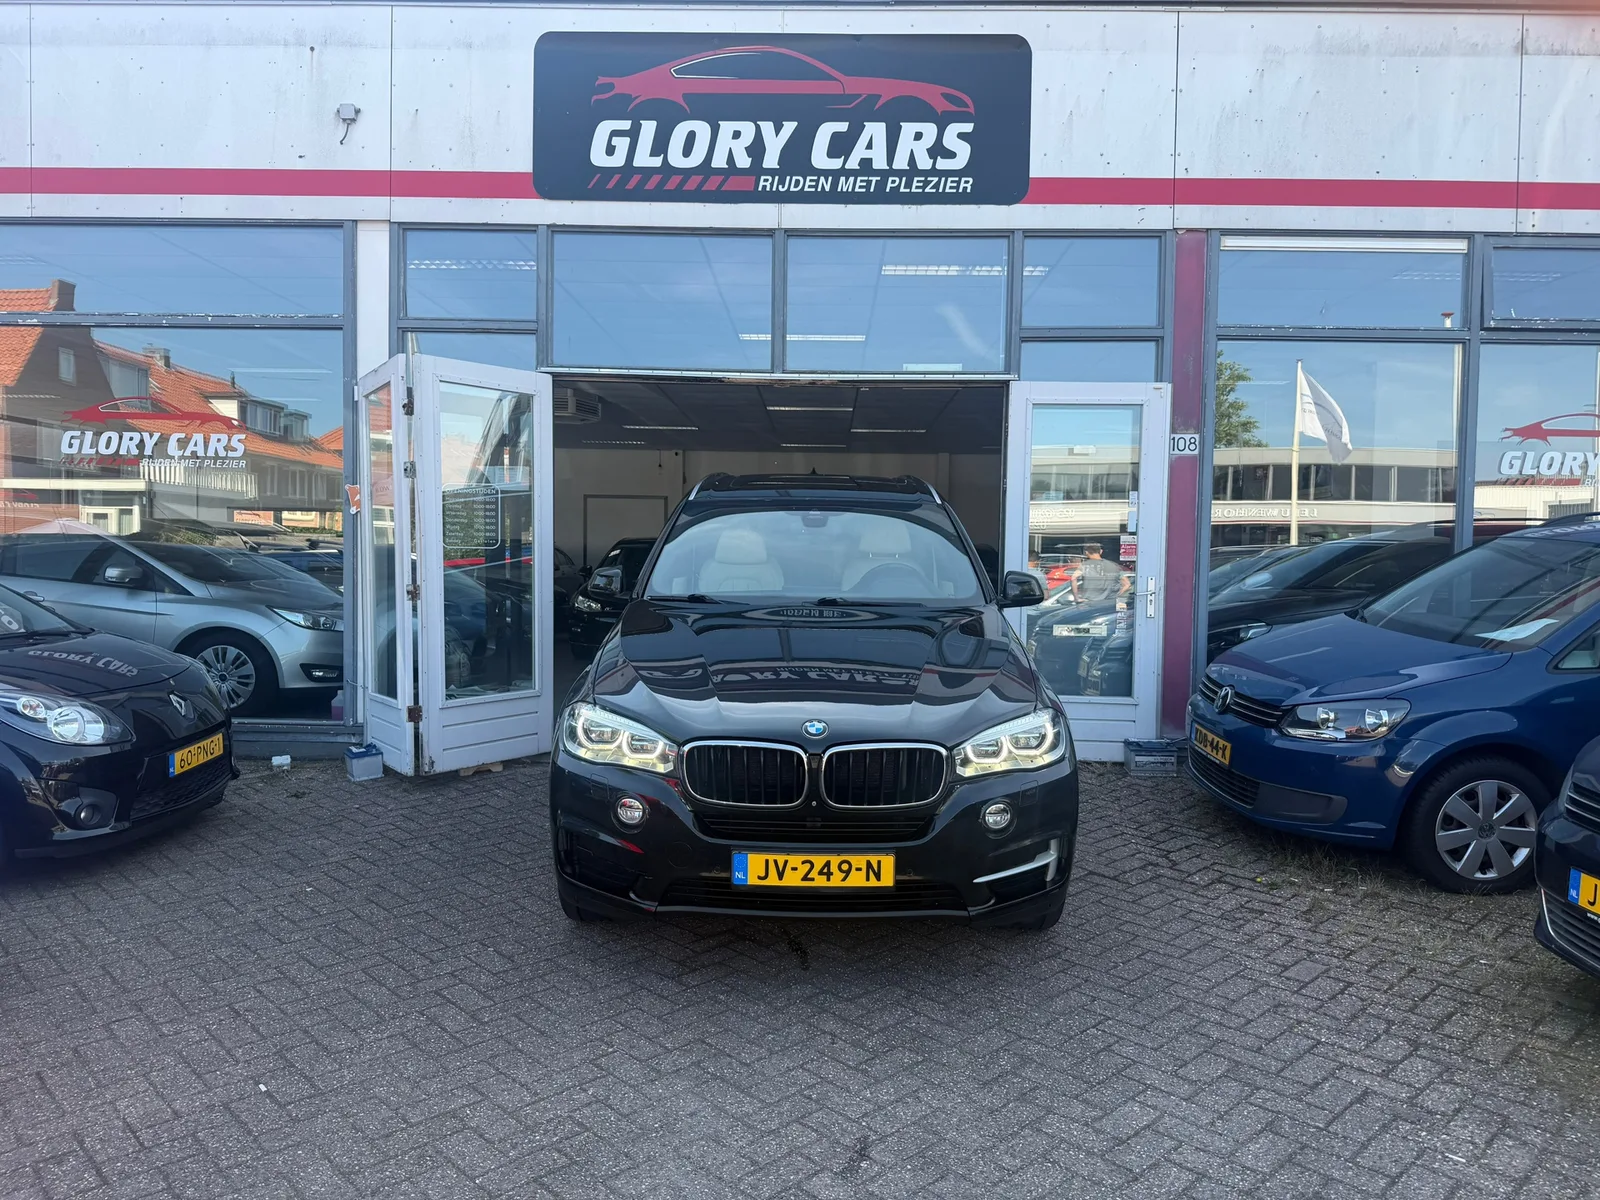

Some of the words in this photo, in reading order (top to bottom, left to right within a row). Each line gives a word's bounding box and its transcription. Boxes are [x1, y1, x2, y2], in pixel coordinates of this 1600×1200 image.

[589, 119, 798, 169] GLORY
[810, 121, 974, 171] CARS
[757, 175, 832, 192] RIJDEN
[837, 176, 880, 192] MET
[885, 176, 974, 193] PLEZIER
[60, 430, 161, 456] GLORY
[167, 433, 246, 458] CARS
[1171, 436, 1198, 452] 108
[180, 459, 201, 468] MET
[204, 459, 247, 469] PLEZIER
[179, 736, 221, 769] 60-PNG-1
[735, 871, 746, 879] NL
[756, 858, 882, 883] JV-249-N
[1570, 888, 1578, 899] NL
